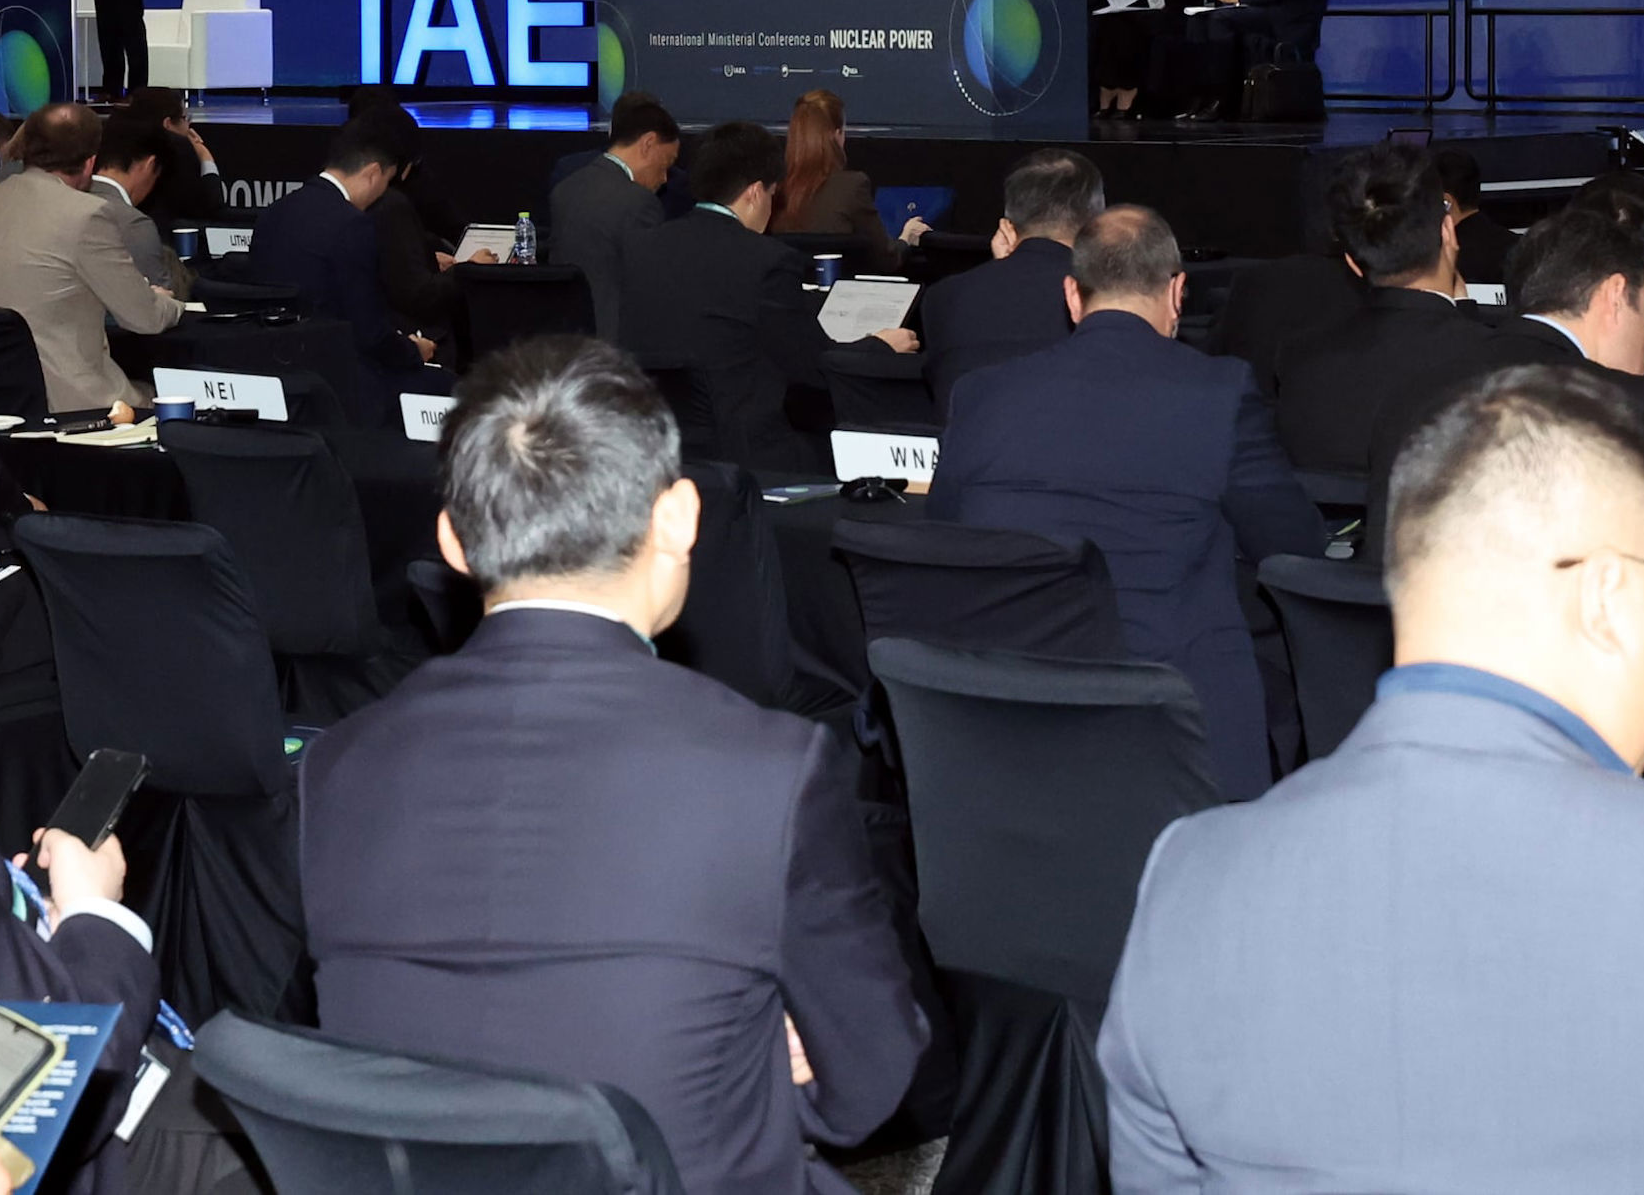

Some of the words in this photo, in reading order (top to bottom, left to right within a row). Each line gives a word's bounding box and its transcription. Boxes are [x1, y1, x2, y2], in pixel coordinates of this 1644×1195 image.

[649, 32, 705, 47] International
[708, 32, 756, 47] Ministerial
[758, 31, 810, 47] Conference
[814, 34, 826, 47] on
[830, 29, 886, 49] NUCLEAR
[889, 29, 933, 49] POWER
[229, 235, 251, 246] LITHU
[203, 380, 236, 401] NEI
